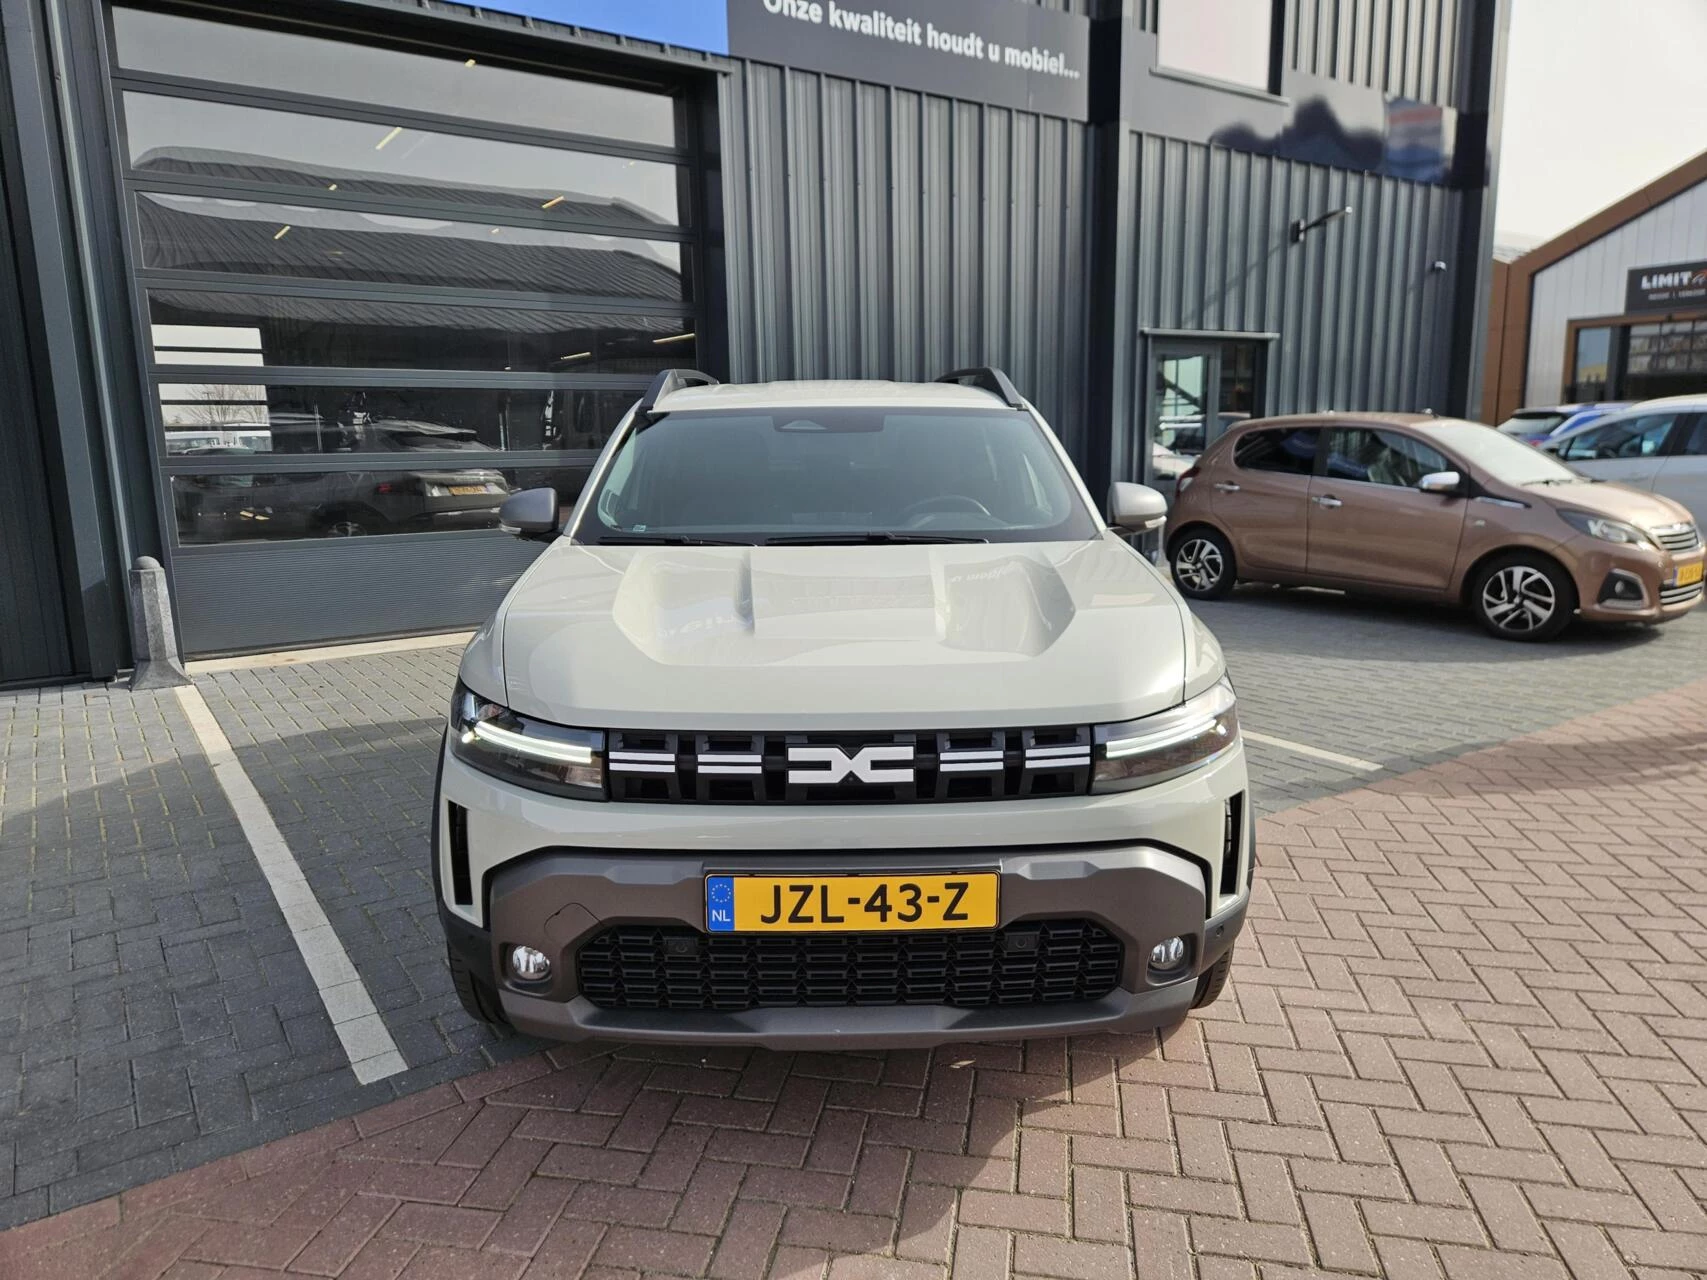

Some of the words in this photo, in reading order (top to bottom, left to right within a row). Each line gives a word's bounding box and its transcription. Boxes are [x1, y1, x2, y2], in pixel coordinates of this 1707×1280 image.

[828, 1, 922, 46] kwaliteit
[926, 23, 984, 59] houdt
[988, 45, 1000, 63] u
[1004, 45, 1080, 79] mobiel...
[711, 909, 731, 922] NL
[760, 882, 969, 924] JZL-43-Z
